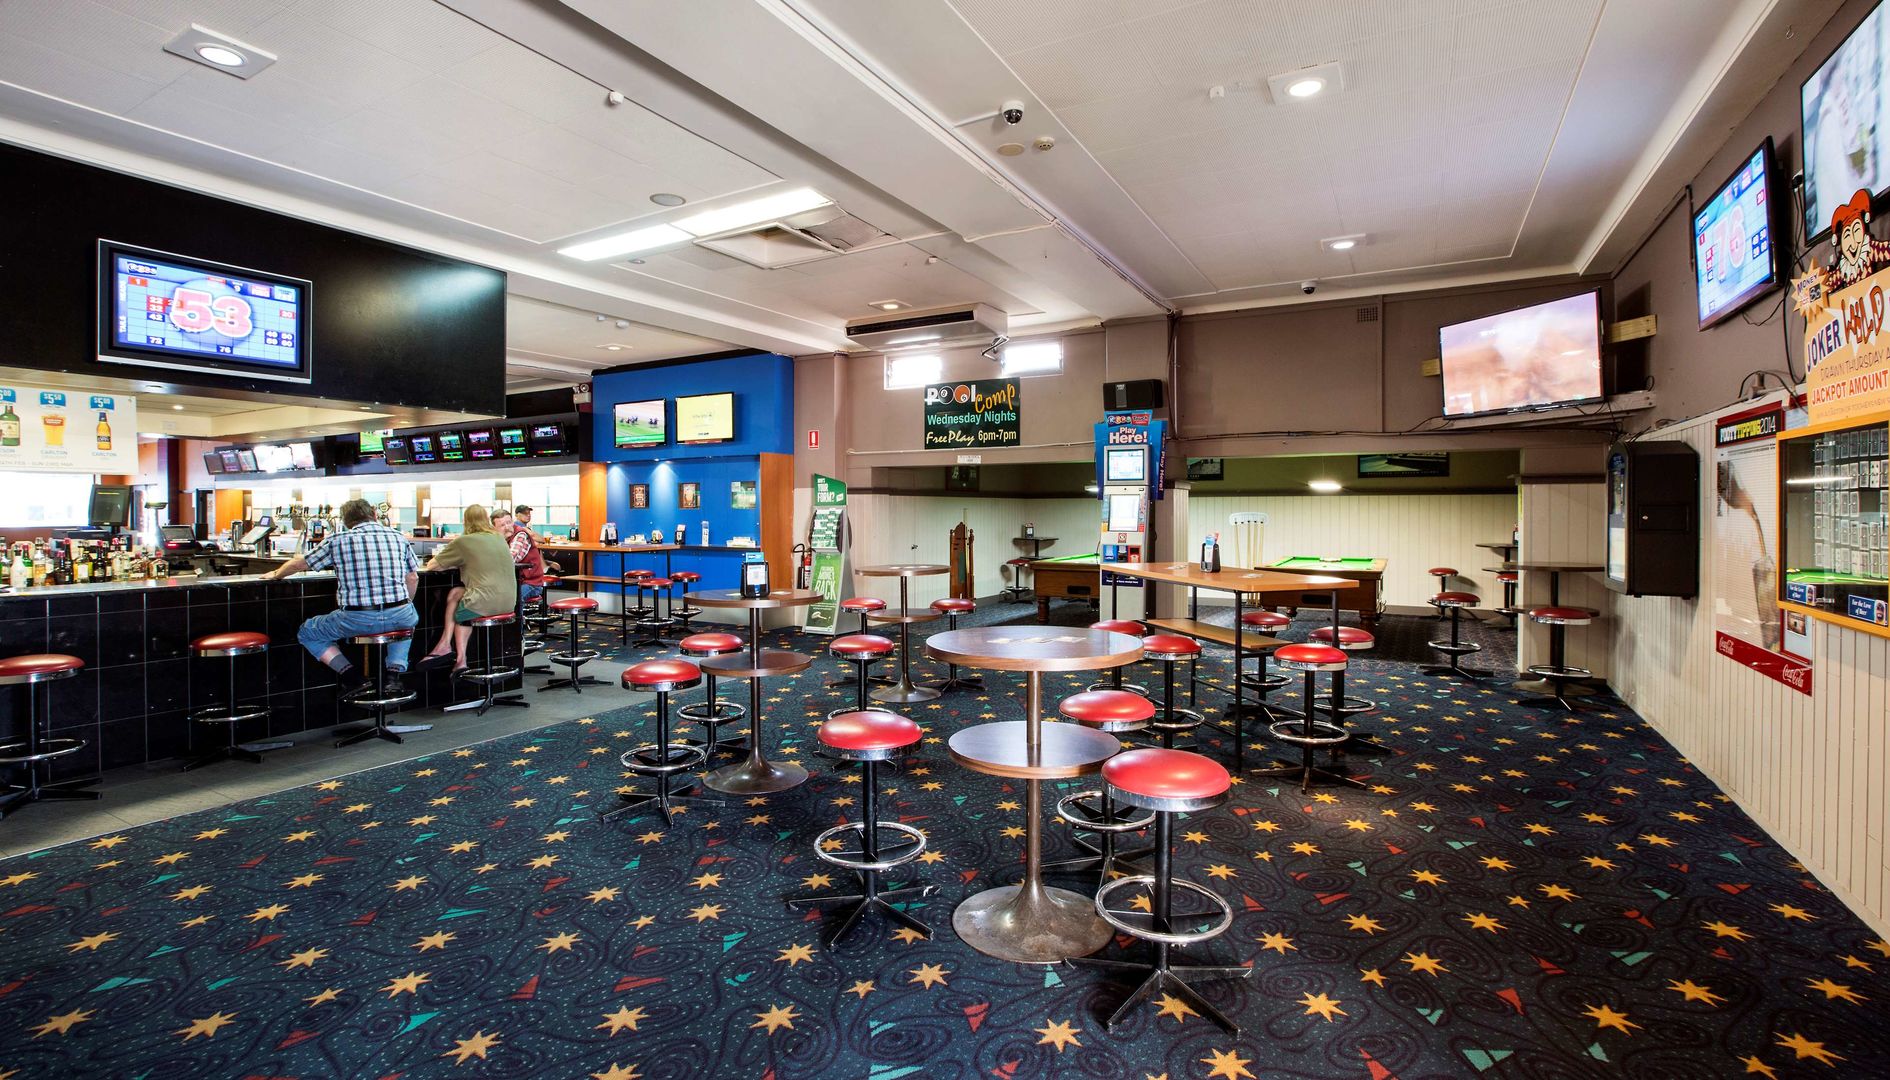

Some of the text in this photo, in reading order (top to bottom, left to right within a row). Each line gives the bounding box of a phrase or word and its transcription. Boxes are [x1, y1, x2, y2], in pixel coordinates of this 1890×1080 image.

[1712, 204, 1746, 282] 76
[1796, 273, 1818, 293] MONEY
[149, 296, 164, 304] 22
[169, 287, 253, 338] 53
[149, 313, 163, 321] 42
[1807, 285, 1885, 372] JOKER WILD
[1820, 362, 1845, 381] DRAWN
[1845, 349, 1885, 374] THURSDAY
[975, 384, 1015, 413] Comp
[1812, 369, 1889, 405] JACKPOT AMOUNT
[927, 410, 1016, 425] Wednesday Nights
[926, 429, 1017, 446] Free Play 6pm-7pm
[1109, 431, 1148, 443] Here!
[1718, 636, 1805, 688] Coca-Cola Coca-Cola
